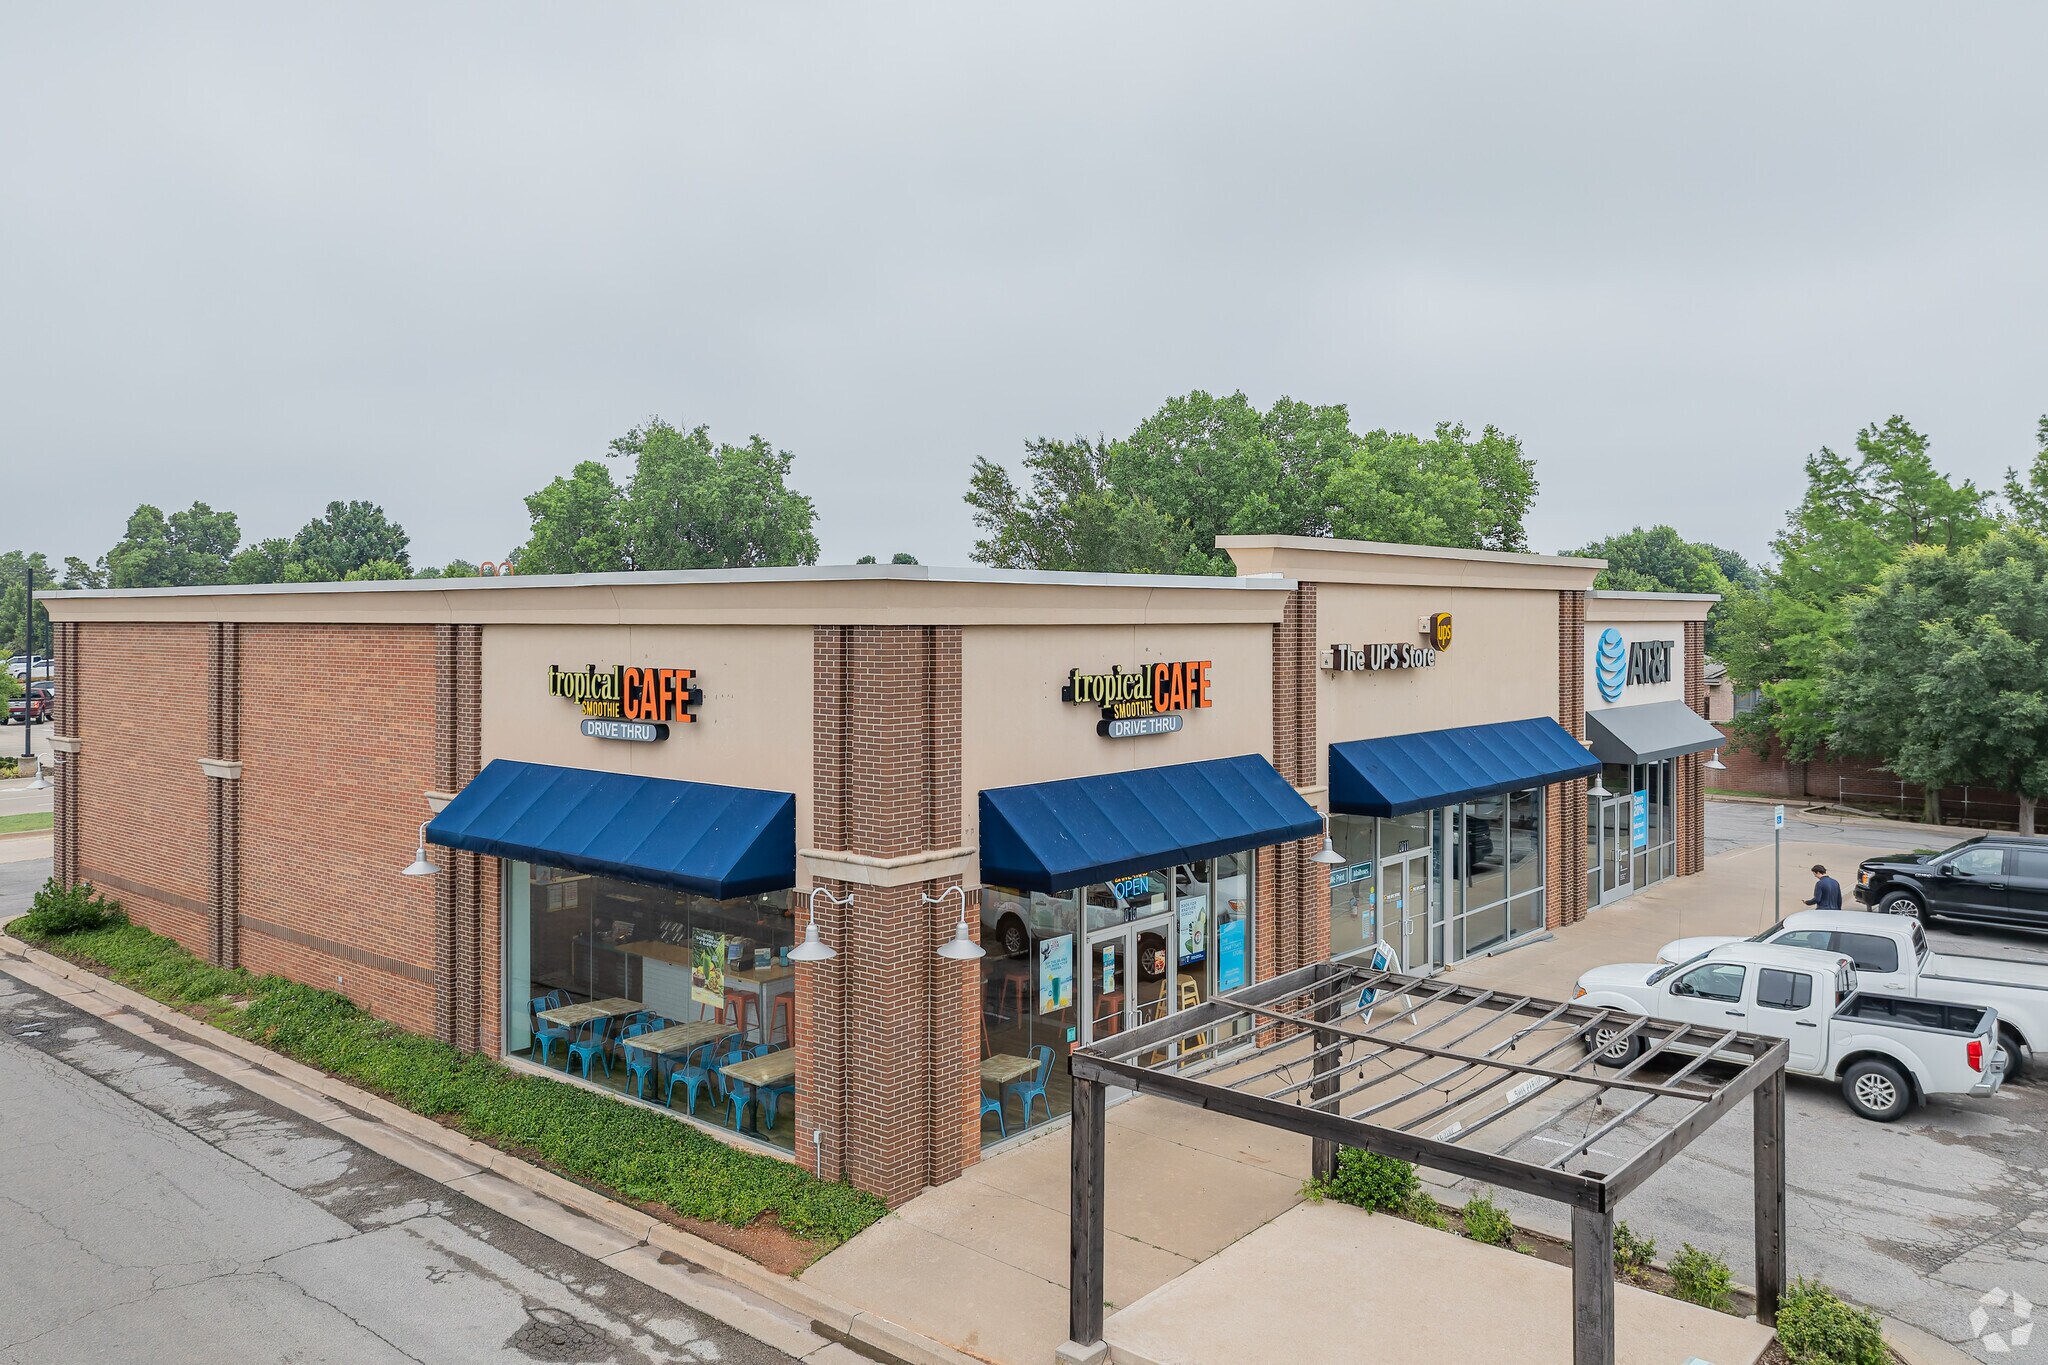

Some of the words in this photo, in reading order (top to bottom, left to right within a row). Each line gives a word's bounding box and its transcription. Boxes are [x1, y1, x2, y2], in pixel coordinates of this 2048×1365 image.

[1437, 625, 1452, 645] ups
[1338, 643, 1366, 671] The
[1370, 643, 1399, 671] UPS
[1401, 642, 1436, 669] Store
[1627, 640, 1675, 686] AT&T
[547, 664, 622, 705] tropical
[623, 667, 695, 723] CAFE
[1072, 663, 1153, 708] tropical
[1153, 660, 1213, 713] CAFE
[582, 700, 620, 718] SMOOTHIE
[1113, 700, 1153, 719] SMOOTHIE
[587, 722, 618, 737] DRIVE
[621, 723, 650, 740] THRU
[1115, 720, 1147, 736] DRIVE
[1149, 717, 1176, 733] THRU
[1115, 875, 1149, 900] OPEN
